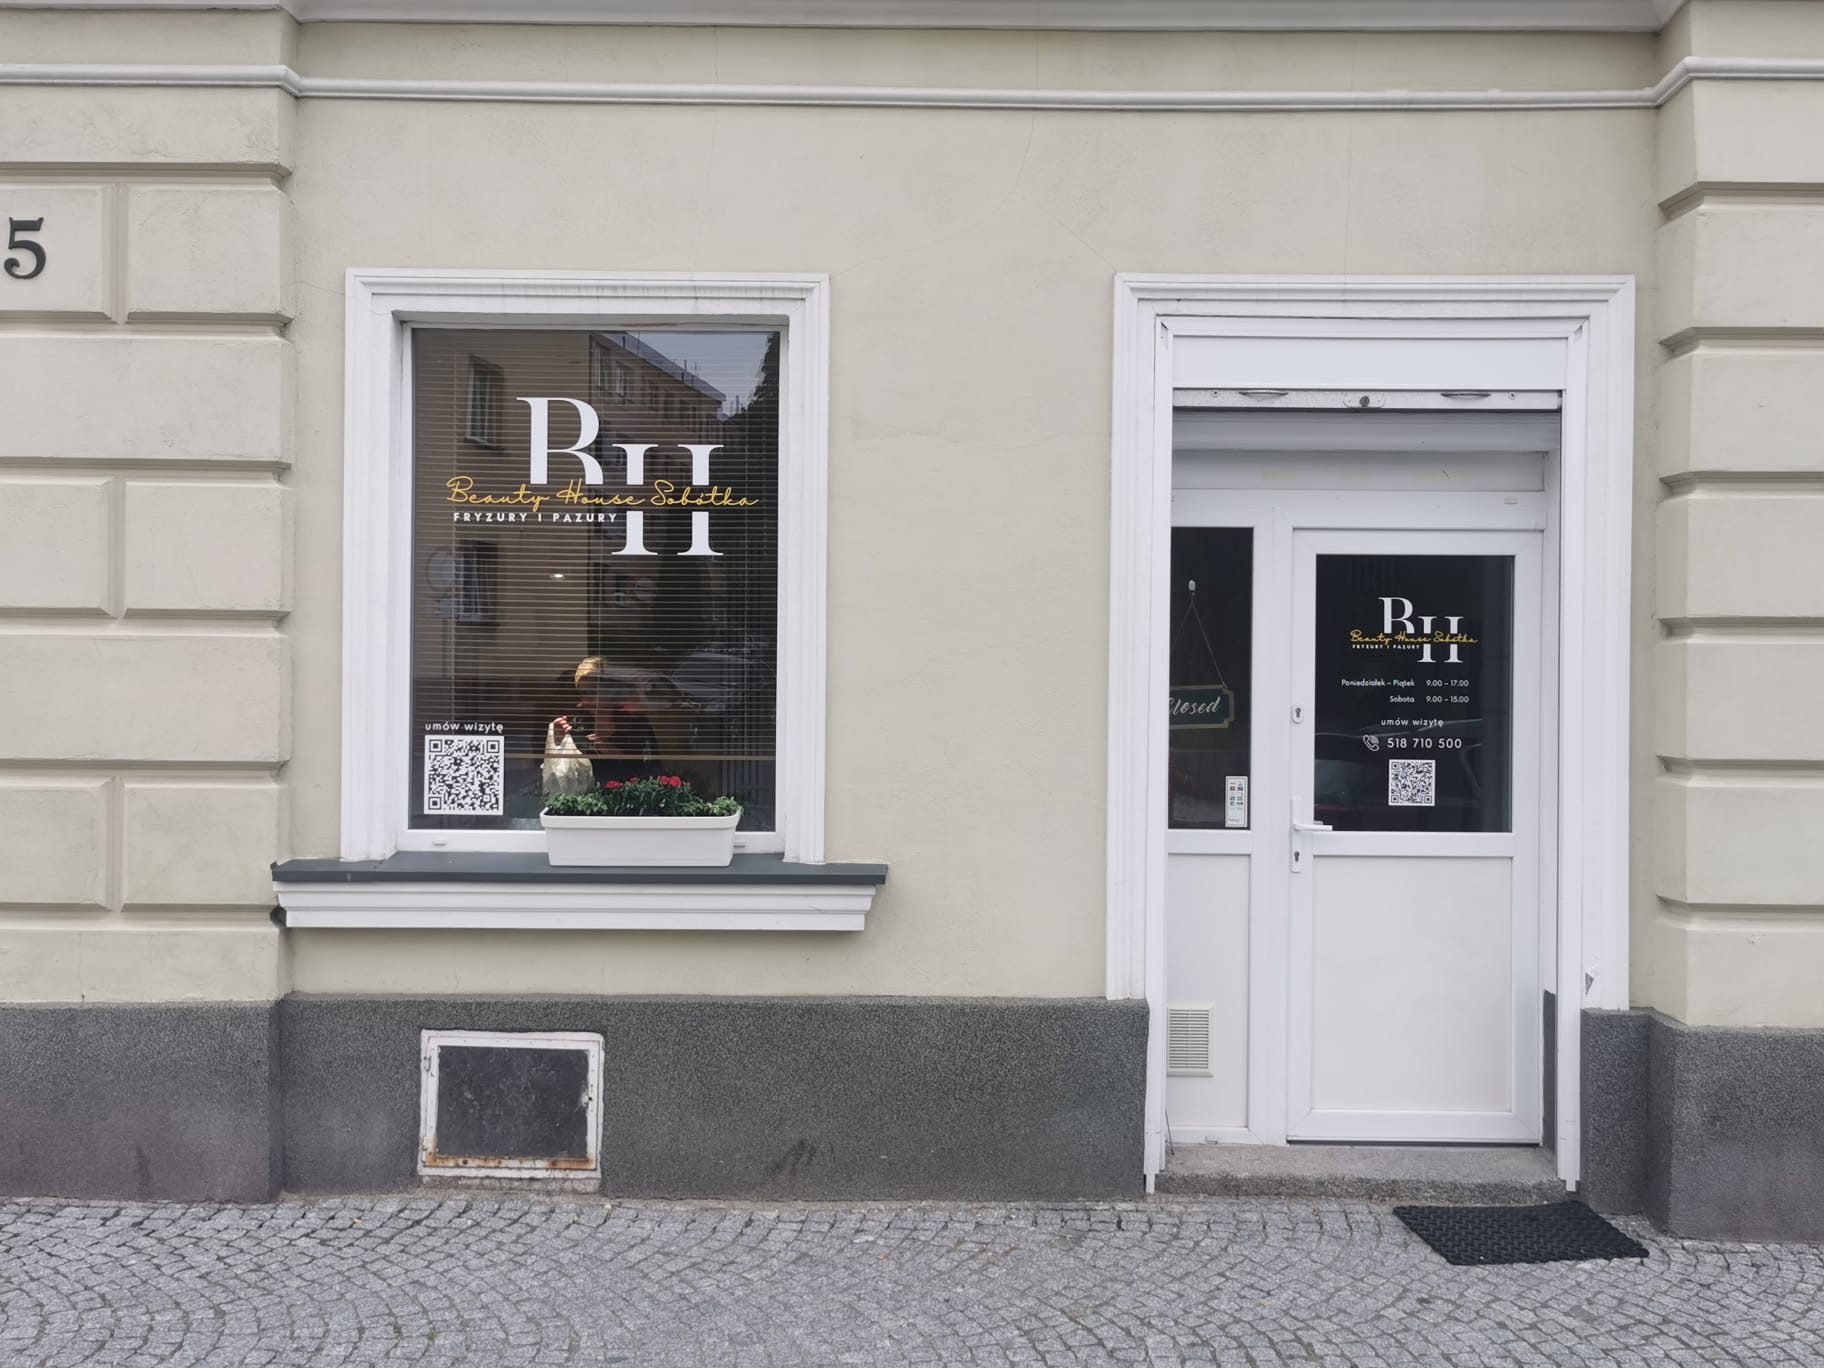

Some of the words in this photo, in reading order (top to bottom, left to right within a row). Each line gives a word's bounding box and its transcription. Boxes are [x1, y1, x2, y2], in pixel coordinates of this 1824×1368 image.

[4, 217, 46, 279] 5
[446, 475, 551, 512] Beauty
[556, 478, 645, 506] House
[453, 512, 528, 522] FRYZURY
[538, 513, 542, 522] I
[552, 513, 618, 523] PAZURY
[1349, 629, 1392, 645] Beauty
[1394, 630, 1431, 643] House
[1341, 678, 1385, 687] Poniedziałek
[1393, 679, 1415, 688] Piątek
[1426, 679, 1442, 687] 9.00
[1450, 679, 1469, 687] 17.00
[1389, 695, 1415, 703] Sobota
[1426, 695, 1442, 703] 9.00
[1450, 695, 1469, 703] 15.00
[425, 720, 460, 731] umów
[464, 720, 504, 734] wizytę
[1381, 717, 1409, 726] umów
[1412, 717, 1444, 728] wizytę
[1387, 738, 1407, 749] 518
[1412, 738, 1433, 749] 710
[1438, 738, 1462, 749] 500
